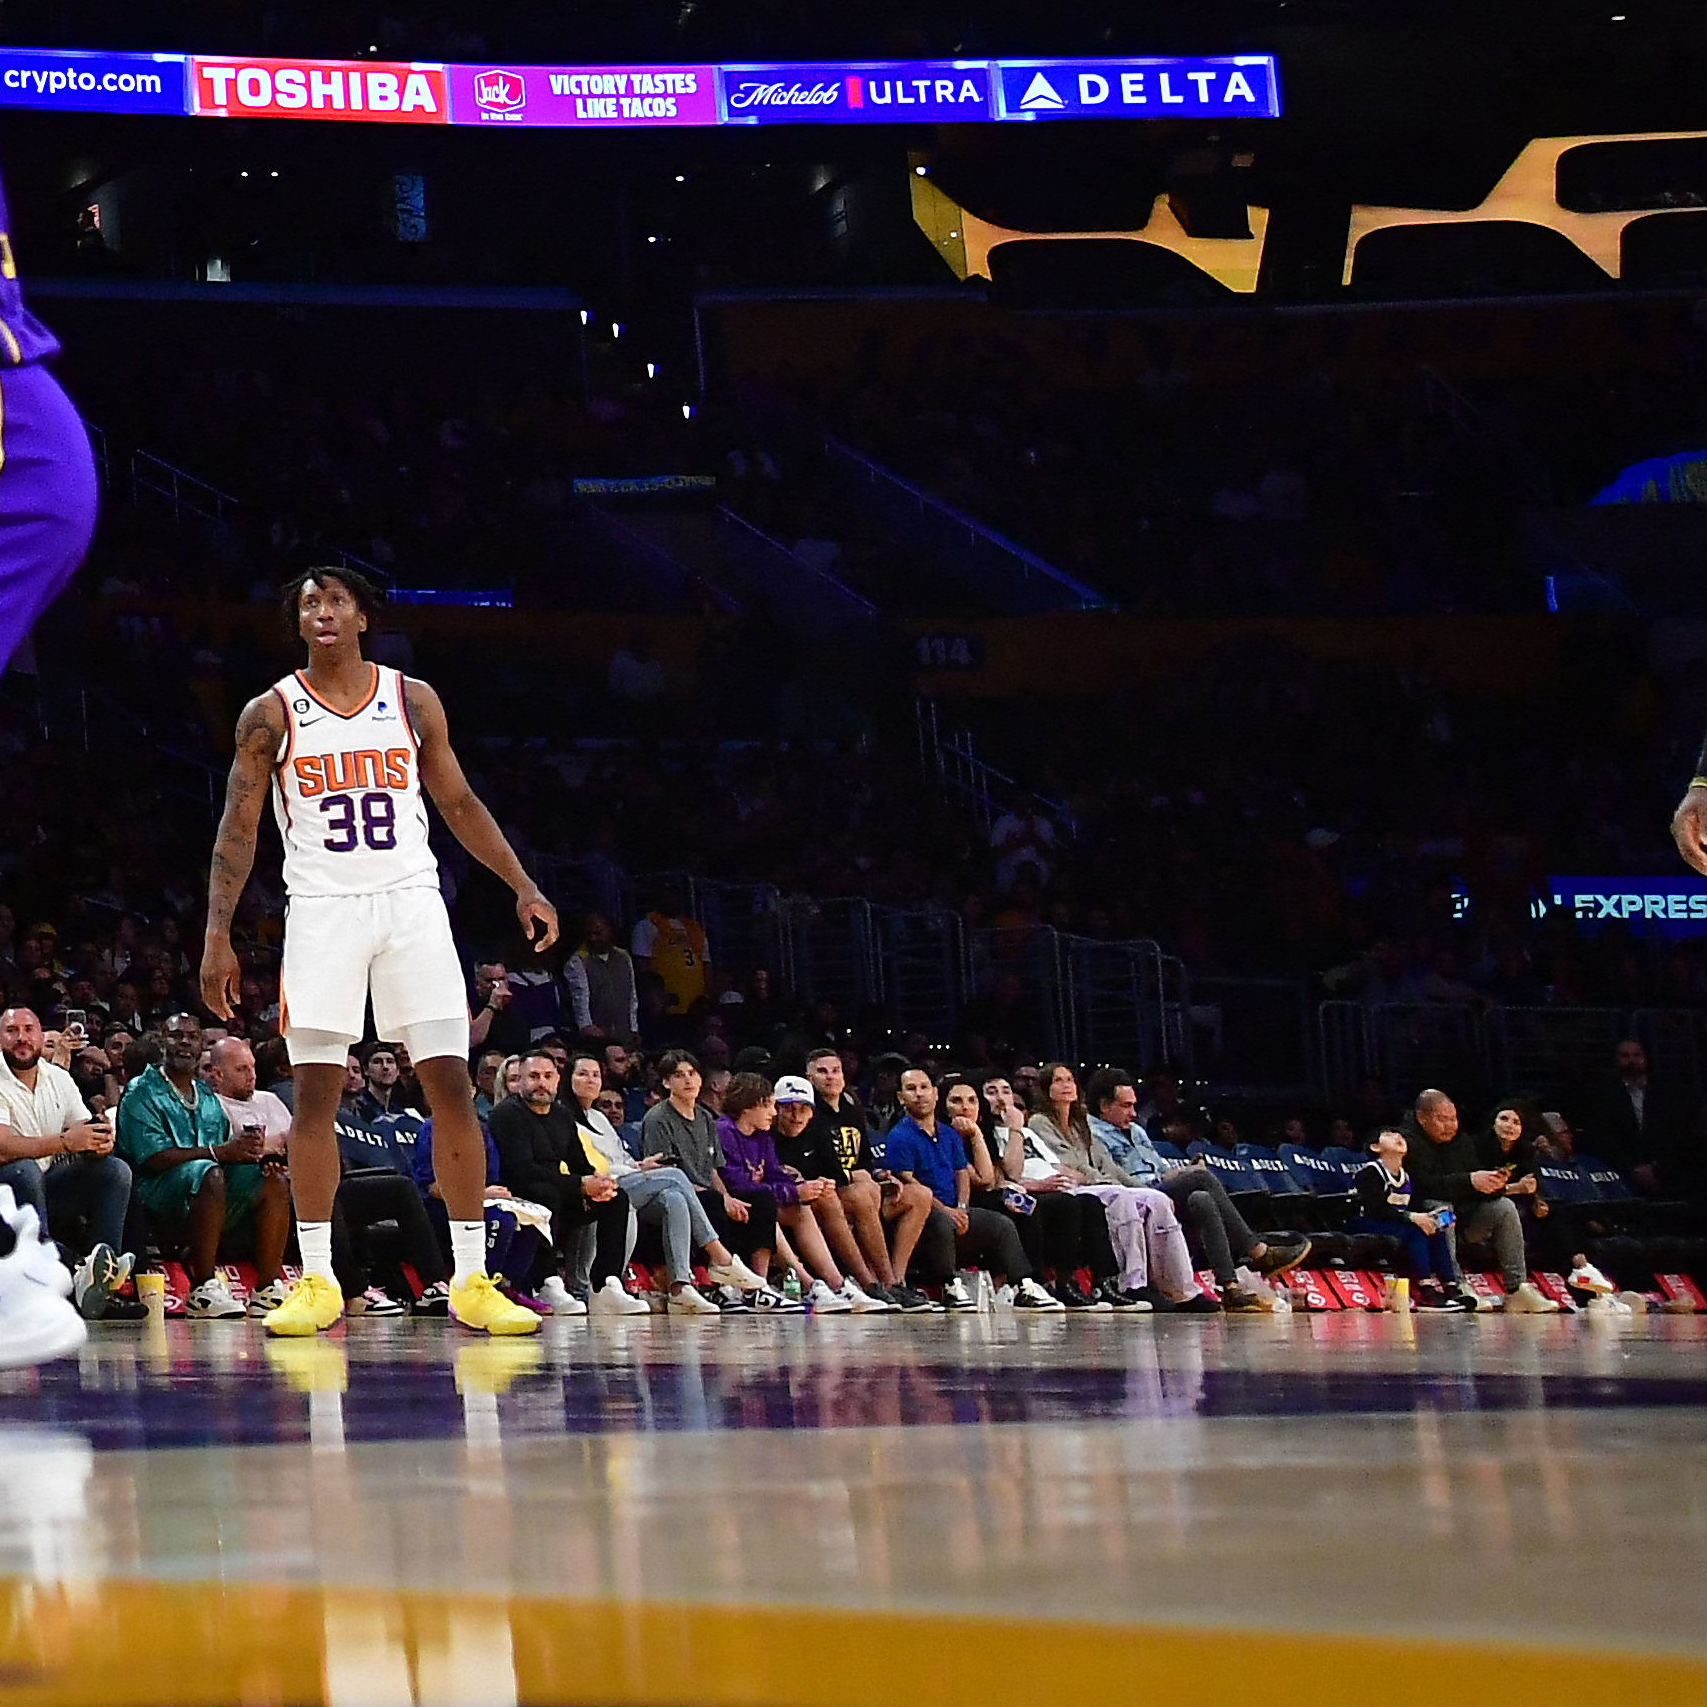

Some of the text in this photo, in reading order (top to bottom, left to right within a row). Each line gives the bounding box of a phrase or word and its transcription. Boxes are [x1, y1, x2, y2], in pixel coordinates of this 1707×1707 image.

[4, 64, 161, 95] crypto.com
[202, 67, 438, 113] TOSHIBA
[549, 73, 697, 96] VICTORY TASTES
[730, 79, 981, 108] Michelob ULTRA
[1078, 71, 1256, 105] DELTA
[576, 96, 677, 119] LIKE TACOS
[320, 791, 397, 852] 38
